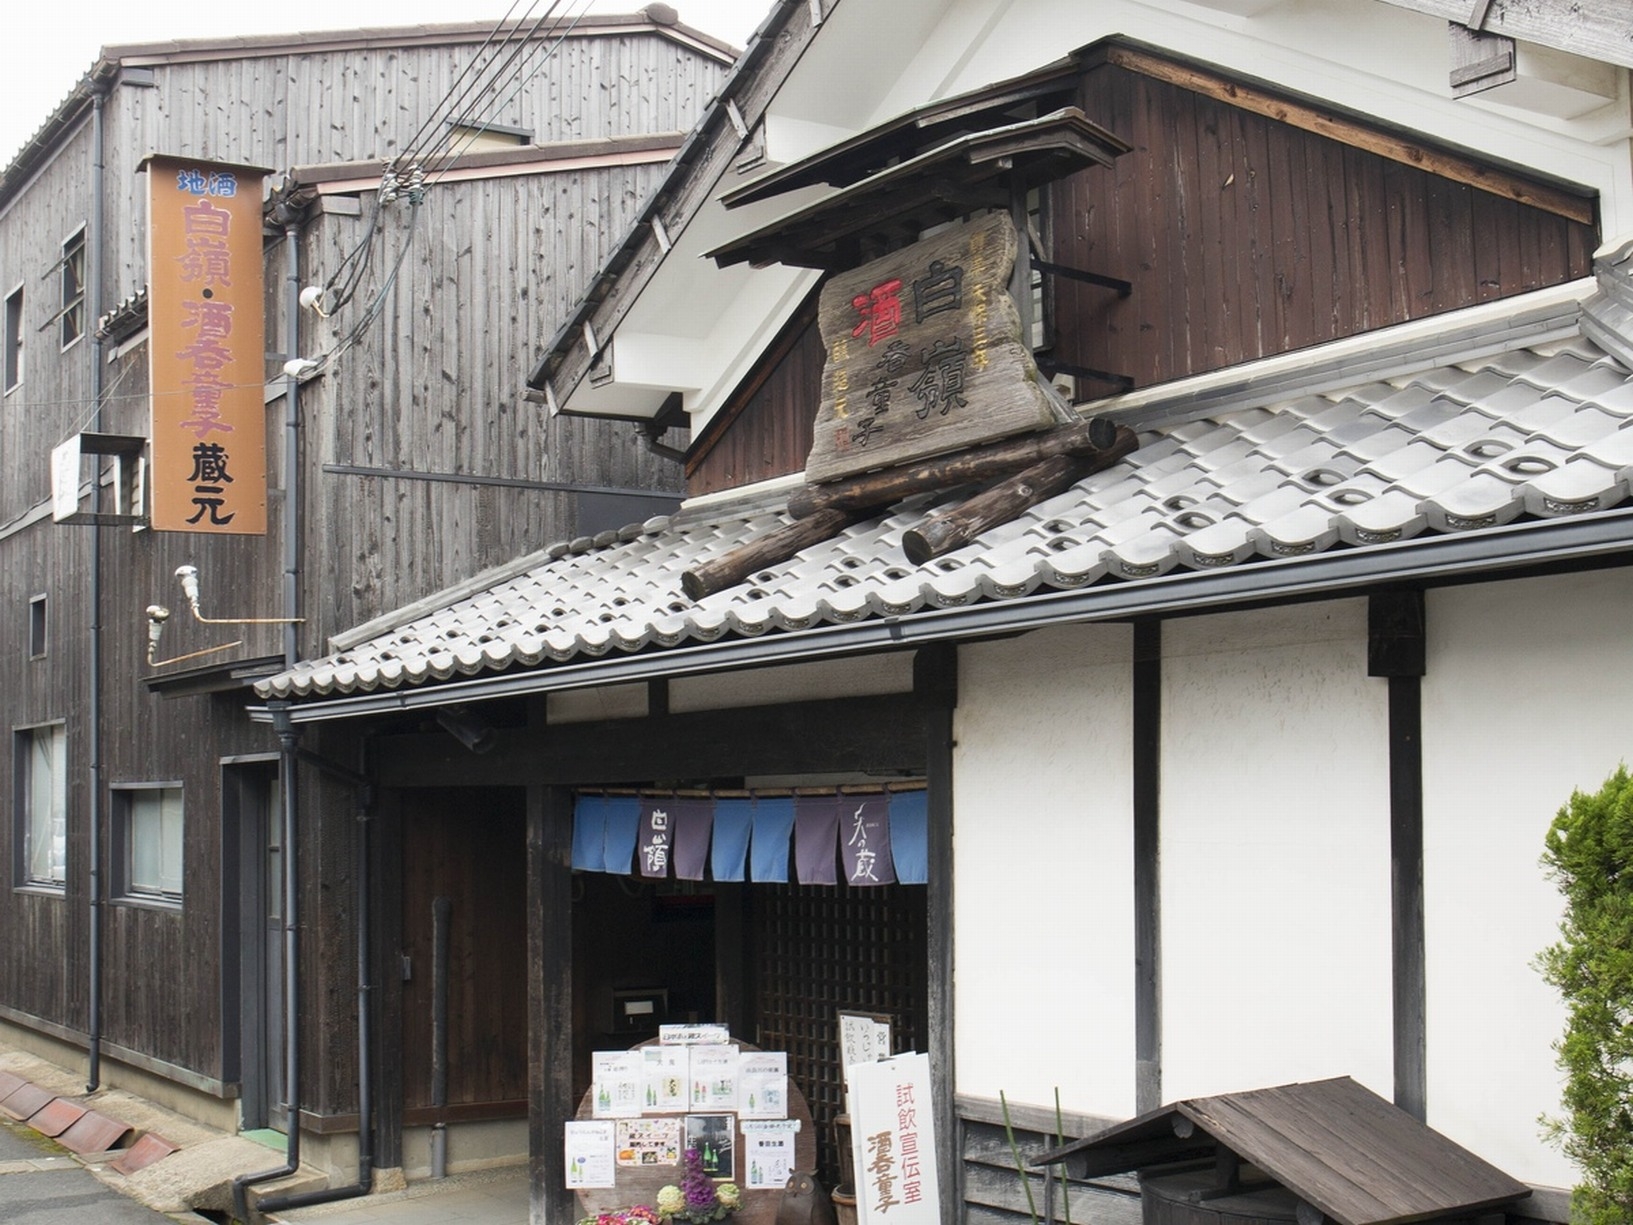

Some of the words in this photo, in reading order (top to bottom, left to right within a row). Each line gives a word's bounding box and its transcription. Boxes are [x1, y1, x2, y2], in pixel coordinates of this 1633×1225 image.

[176, 169, 238, 198] 地酒
[185, 442, 236, 526] 蔵元
[896, 1083, 922, 1205] 試飲宣伝室
